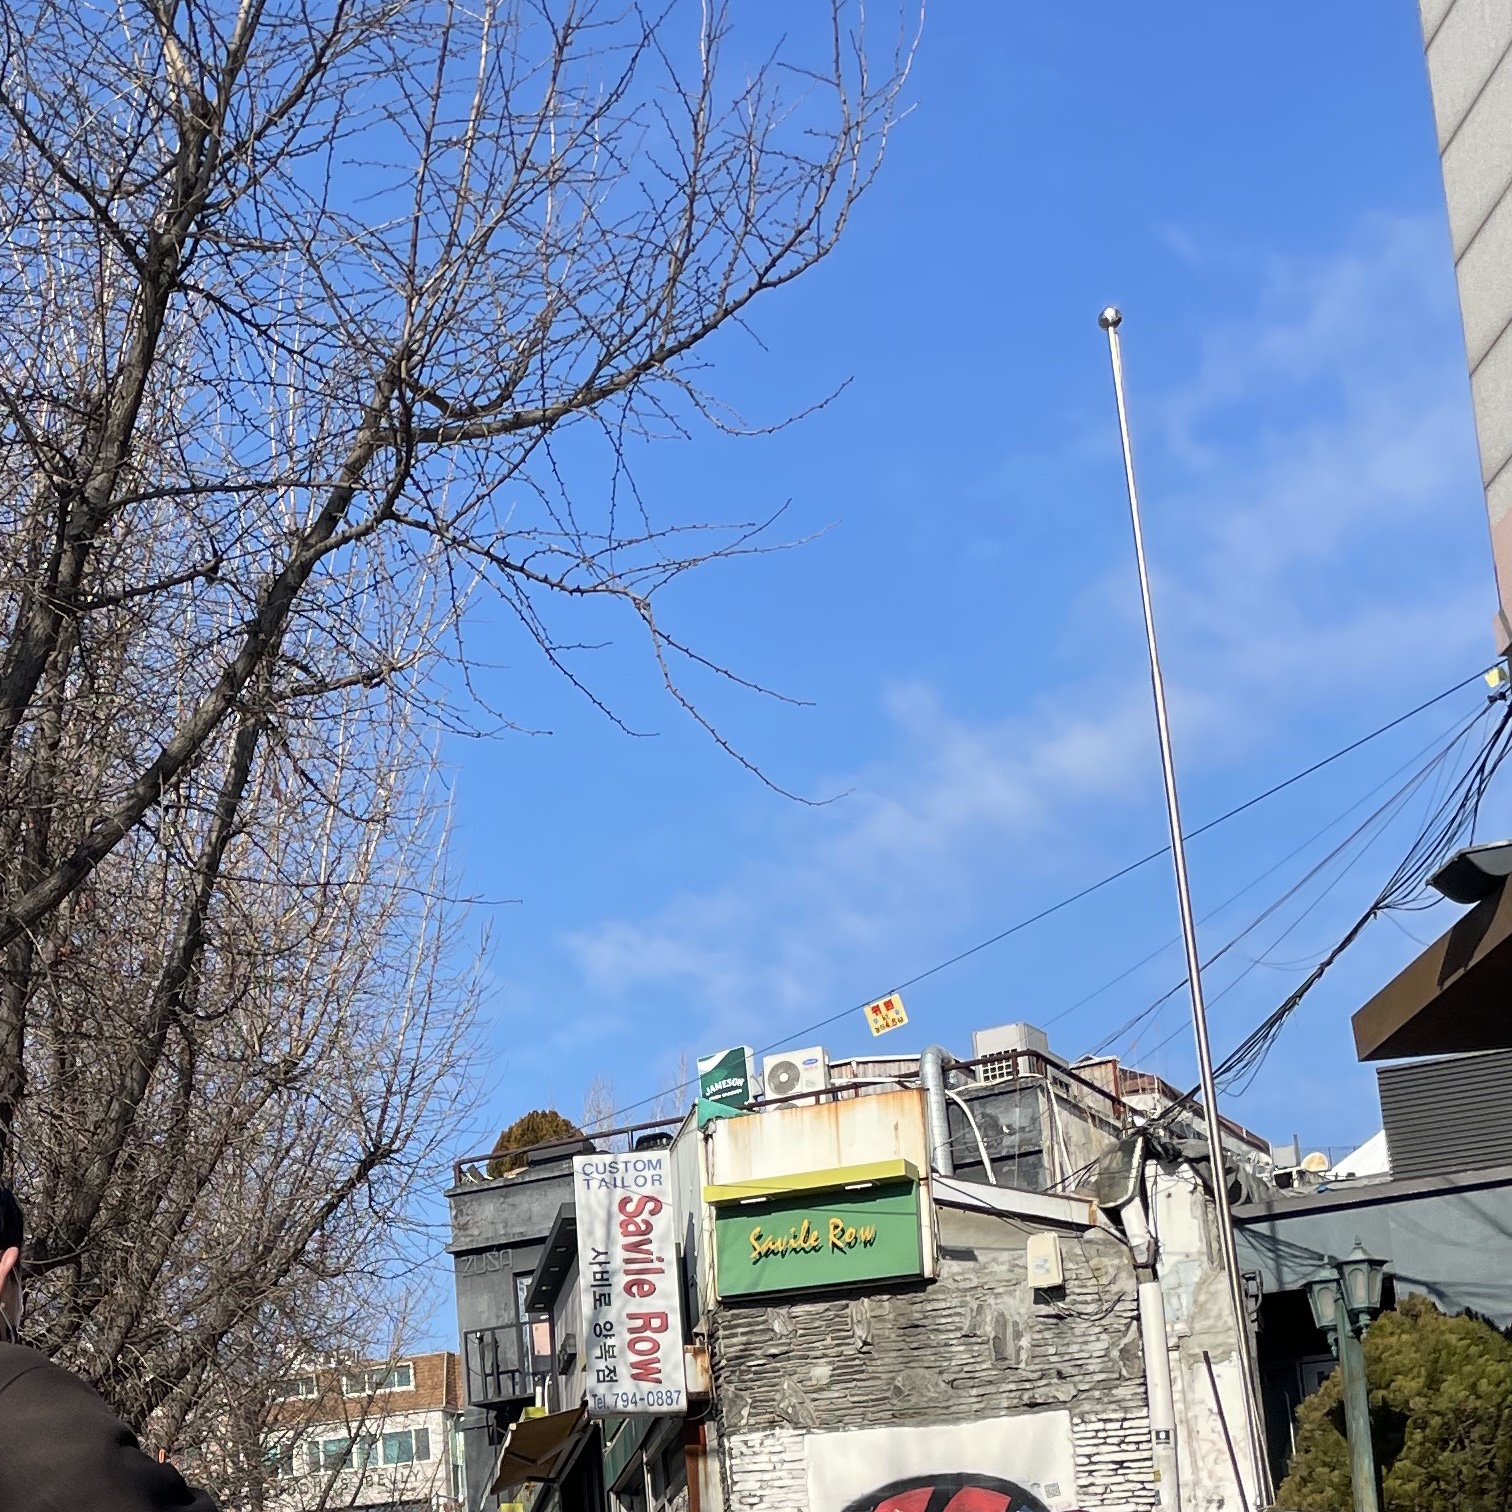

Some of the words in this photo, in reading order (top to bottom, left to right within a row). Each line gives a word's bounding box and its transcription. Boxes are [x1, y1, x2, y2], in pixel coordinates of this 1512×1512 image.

[705, 1077, 745, 1096] JAMESON
[582, 1158, 663, 1177] CUSTOM
[582, 1174, 663, 1191] TAILOR
[618, 1195, 665, 1299] Savile
[749, 1218, 822, 1261] Savile
[828, 1217, 877, 1250] Row
[589, 1246, 613, 1311] 사비로
[593, 1320, 619, 1384] 양복점
[626, 1311, 669, 1385] Row
[612, 1390, 682, 1409] 794-0887
